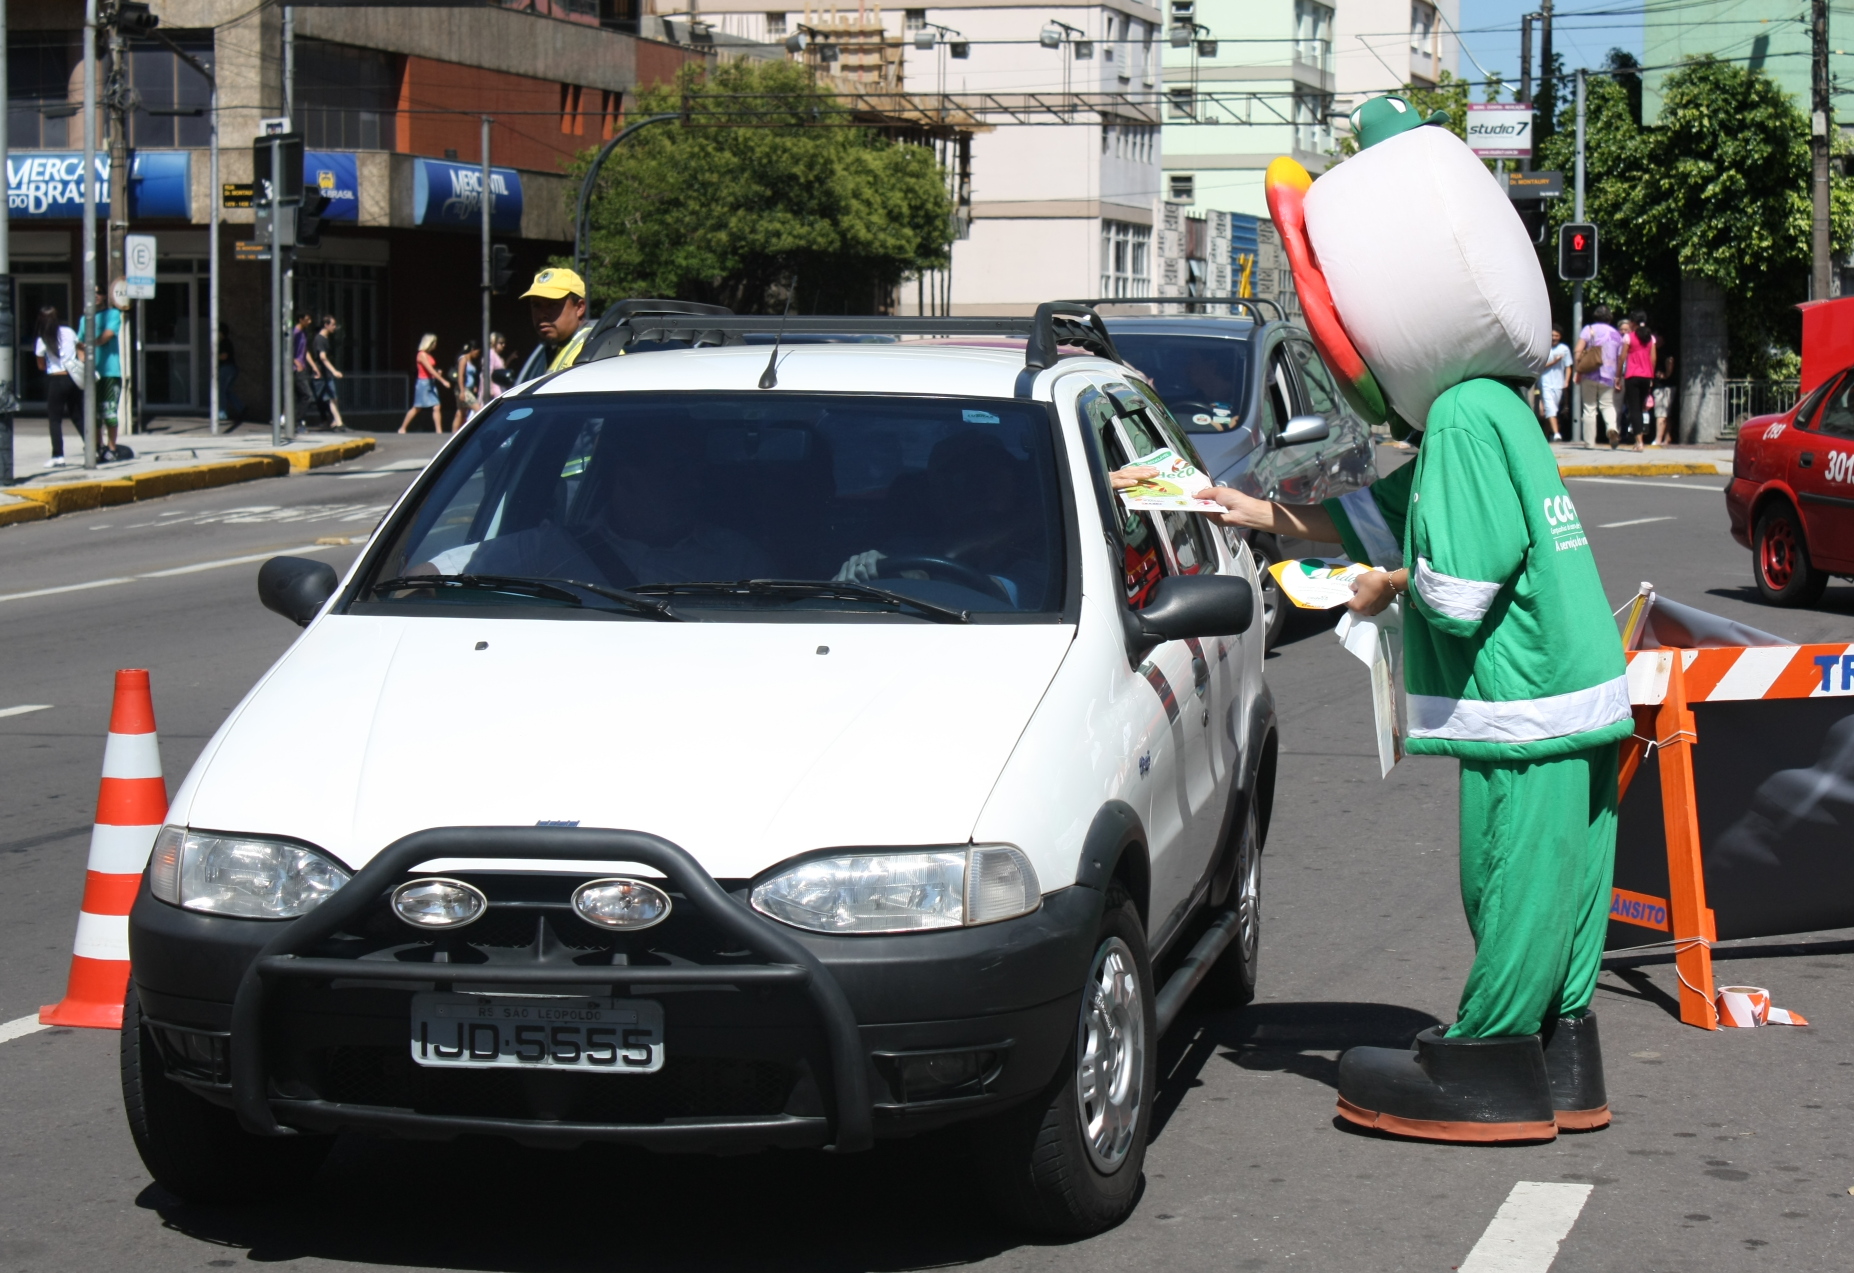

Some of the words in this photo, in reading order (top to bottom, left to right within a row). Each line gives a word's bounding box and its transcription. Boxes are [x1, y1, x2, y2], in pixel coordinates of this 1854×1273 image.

[9, 195, 29, 208] DO
[137, 249, 146, 265] E
[1825, 450, 1854, 484] 301
[478, 1007, 494, 1018] RS
[537, 1010, 602, 1021] LEOPOLDO
